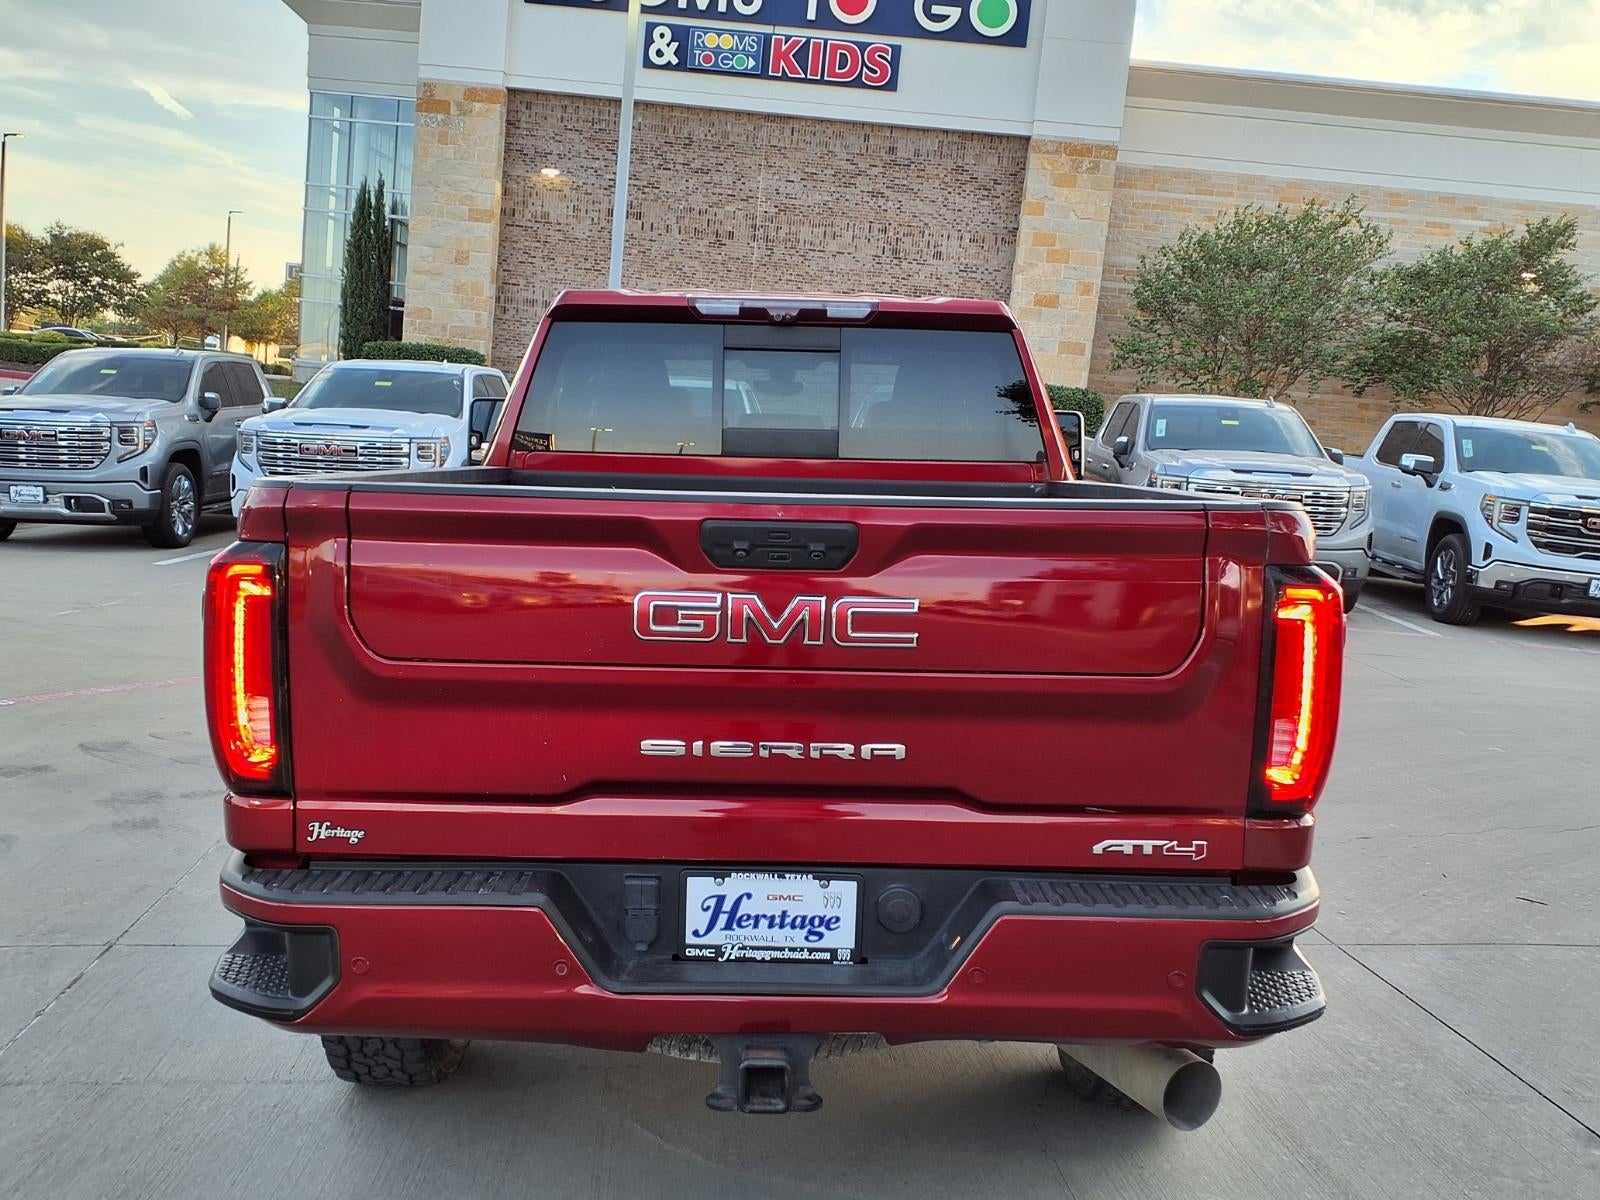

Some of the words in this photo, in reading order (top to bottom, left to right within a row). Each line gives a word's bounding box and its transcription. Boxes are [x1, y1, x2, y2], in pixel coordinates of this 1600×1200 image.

[914, 0, 1018, 37] GO
[648, 25, 680, 66] &
[694, 31, 758, 51] ROOMS
[694, 51, 714, 67] TO
[718, 52, 749, 69] GO
[768, 35, 892, 86] KIDS
[300, 443, 356, 457] GMC
[633, 591, 920, 648] GMC
[640, 739, 906, 760] SIERRA
[306, 821, 365, 845] Heritage
[1092, 839, 1208, 861] AT4
[785, 873, 813, 881] TEXAS
[766, 894, 804, 902] GMC
[692, 892, 841, 943] Heritage
[784, 935, 796, 943] TX
[685, 948, 716, 957] GMC
[717, 943, 831, 962] Heritagegmcbuick.com
